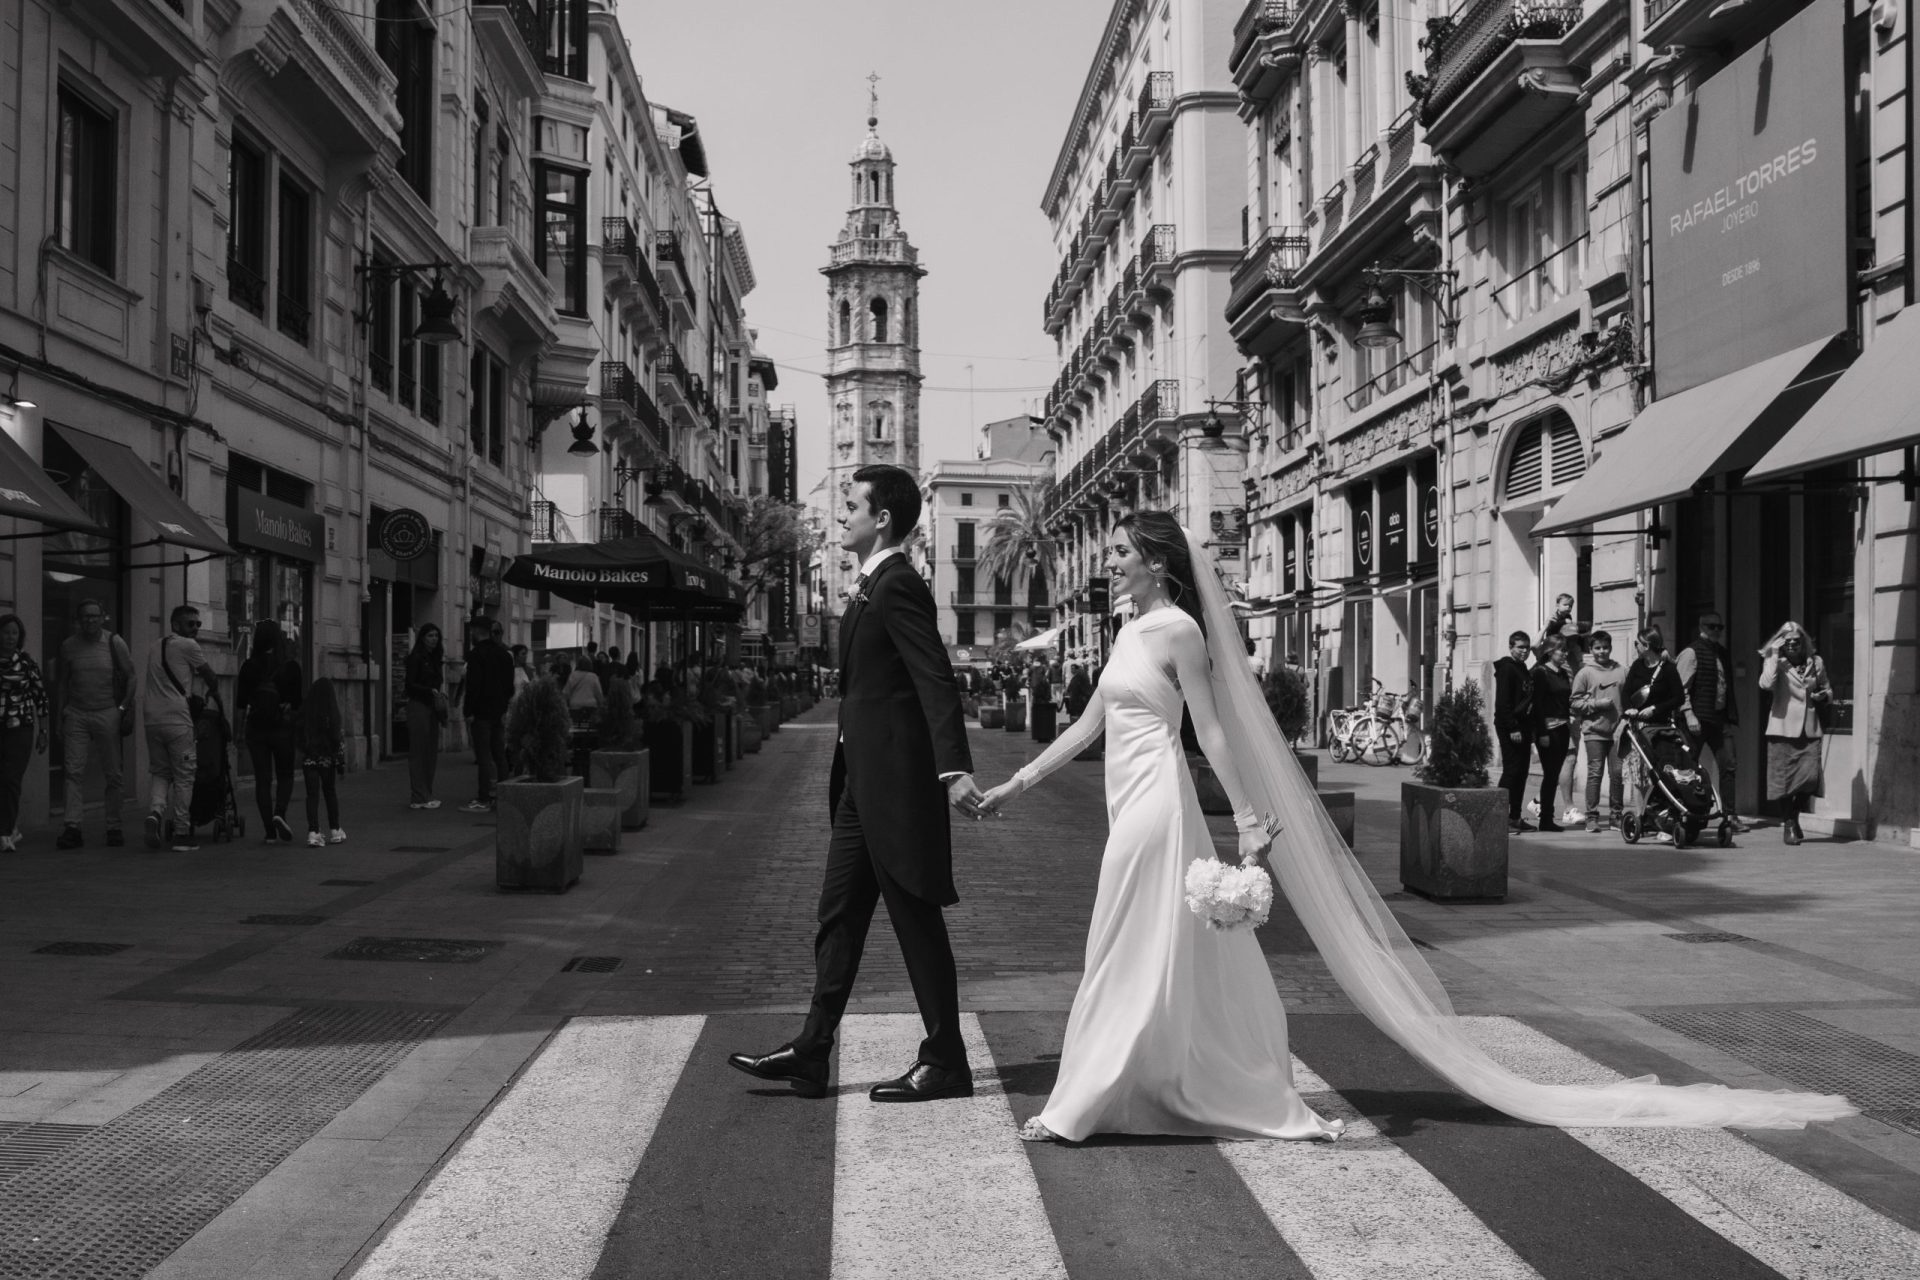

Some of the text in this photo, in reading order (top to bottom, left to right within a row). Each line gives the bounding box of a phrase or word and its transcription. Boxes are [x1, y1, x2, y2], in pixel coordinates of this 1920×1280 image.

[1670, 137, 1817, 237] RAFAEL TORRES
[1720, 200, 1759, 233] JOYERO
[1722, 265, 1744, 287] DESDE
[255, 507, 288, 541] Manolo
[288, 519, 312, 548] Bakes
[533, 563, 649, 583] Manolo Bakes
